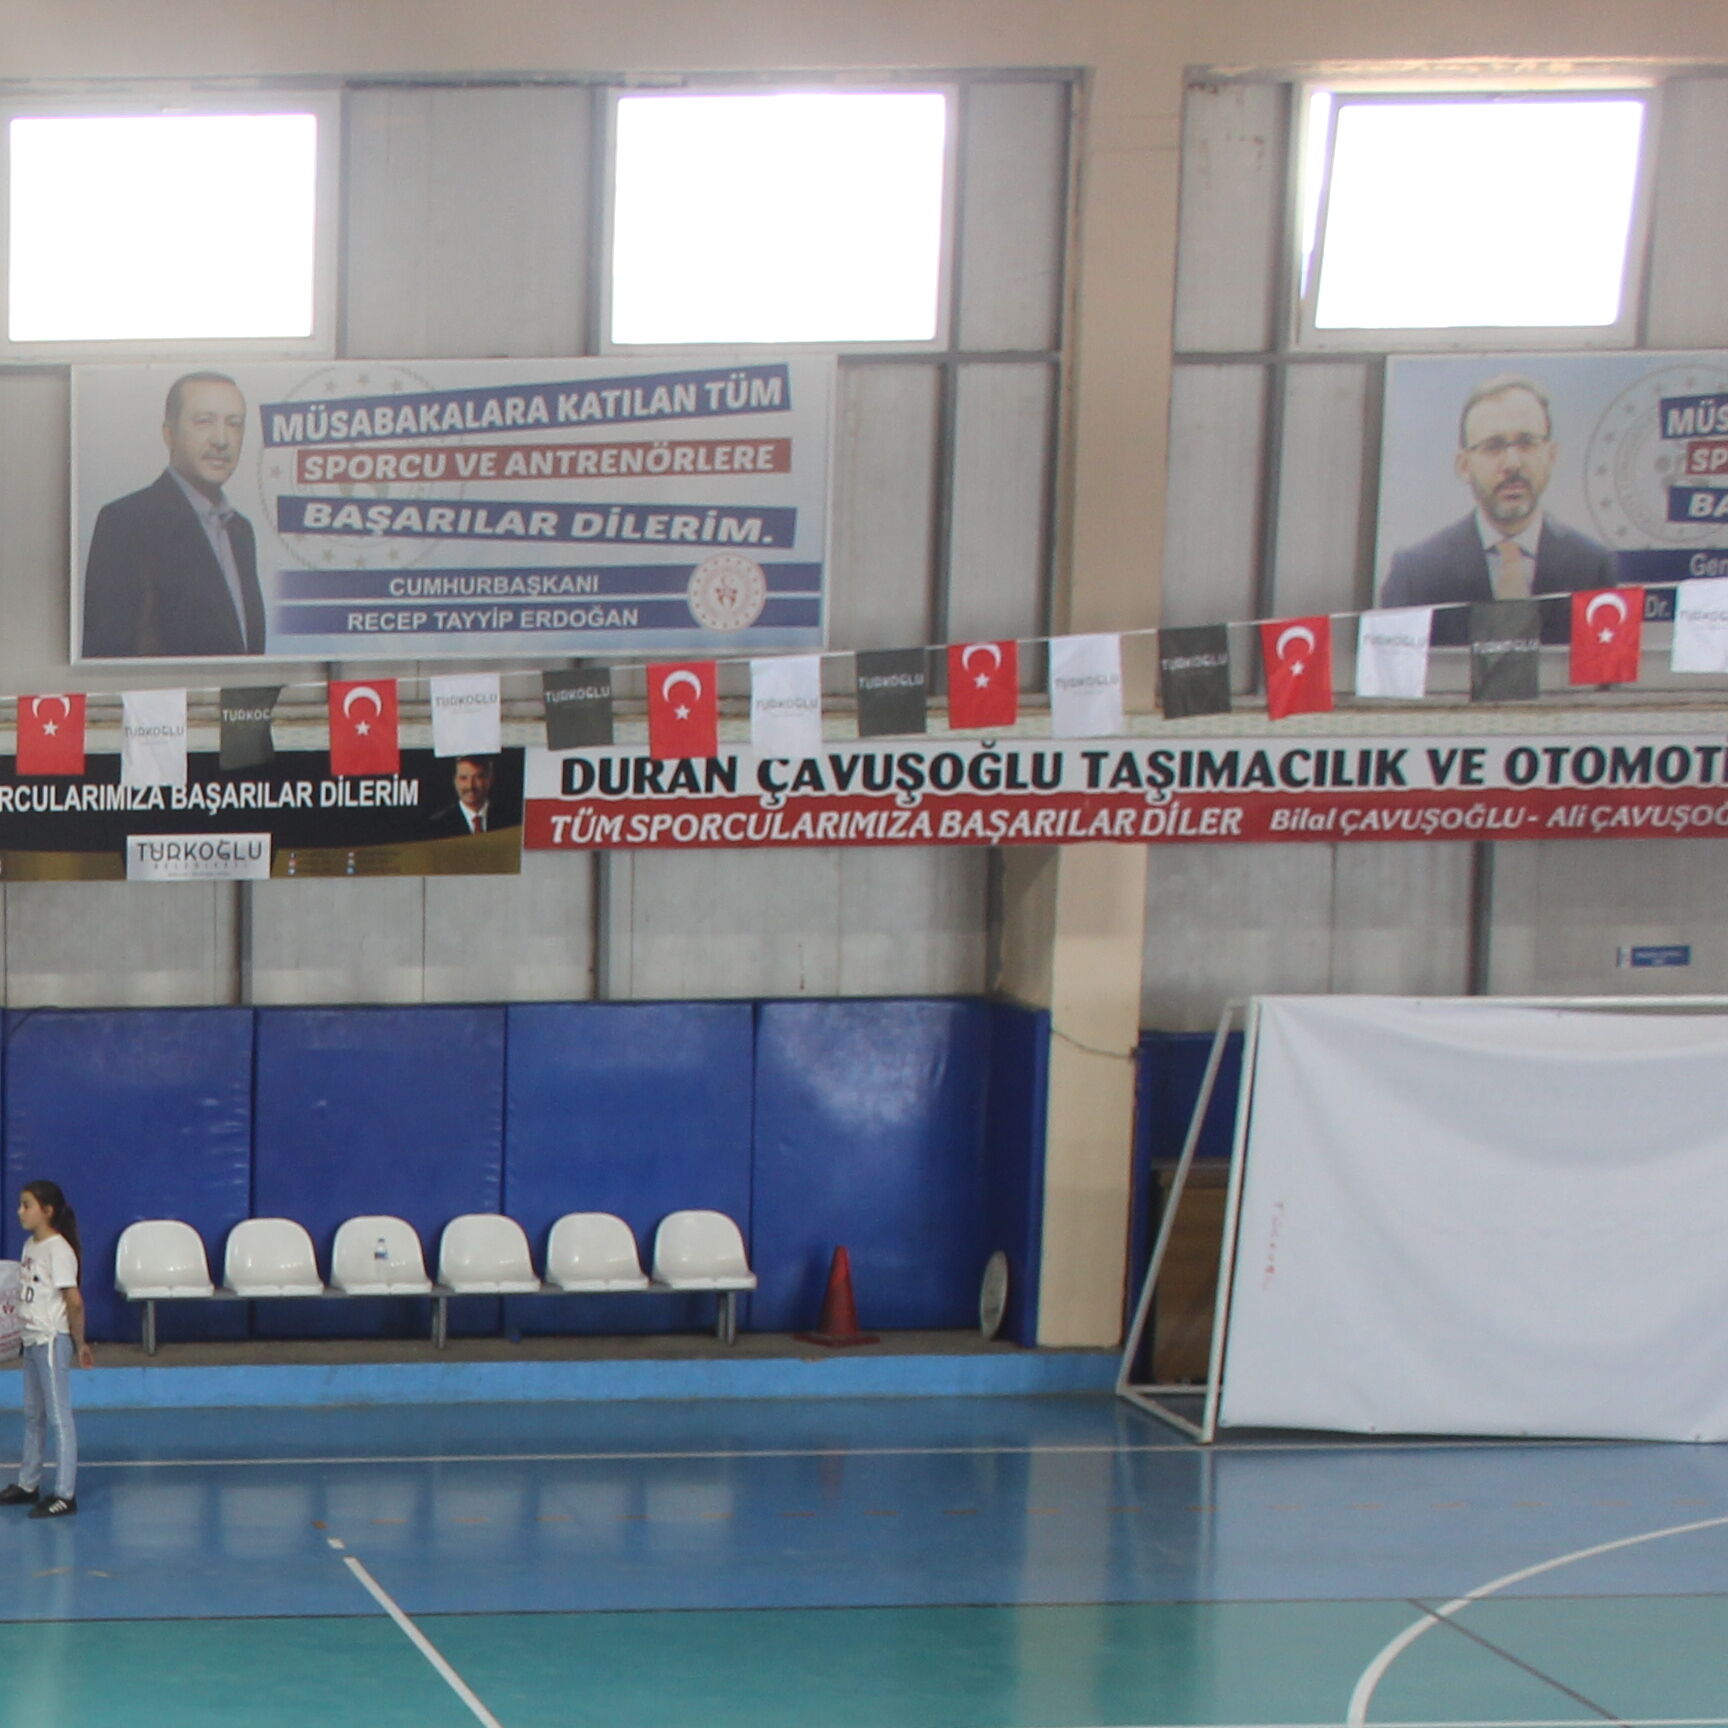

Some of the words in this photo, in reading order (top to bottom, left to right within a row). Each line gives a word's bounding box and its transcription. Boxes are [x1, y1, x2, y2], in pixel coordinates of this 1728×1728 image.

[272, 394, 547, 443] MÜSABAKALARA
[557, 382, 698, 422] KATILAN
[705, 373, 783, 409] TÜM
[304, 451, 446, 481] SPORCU
[455, 451, 497, 477] VE
[504, 441, 775, 476] ANTRENÖRLERE
[303, 501, 558, 538] BAŞARILAR
[571, 504, 774, 545] DİLERİM.
[389, 573, 600, 599] CUMHURBAŞKANI
[348, 610, 427, 632] RECEP
[431, 606, 513, 629] TAYYİP
[520, 604, 638, 628] ERDOĞAN
[561, 756, 738, 795] DURAN
[757, 740, 1063, 805] ÇAVUŞOĞLU
[1081, 748, 1410, 802] TAŞIMACILIK
[1427, 748, 1487, 785] VE
[1504, 745, 1728, 785] OTOMOT
[171, 780, 312, 816] BAŞARILAR
[320, 773, 419, 808] DİLERİM
[550, 808, 625, 844] TÜM
[626, 808, 932, 844] SPORCULARIMIZA
[939, 806, 1135, 844] BAŞARILAR
[1143, 800, 1243, 837] DİLER
[1270, 806, 1335, 831] Bilal
[1547, 804, 1586, 828] Ali
